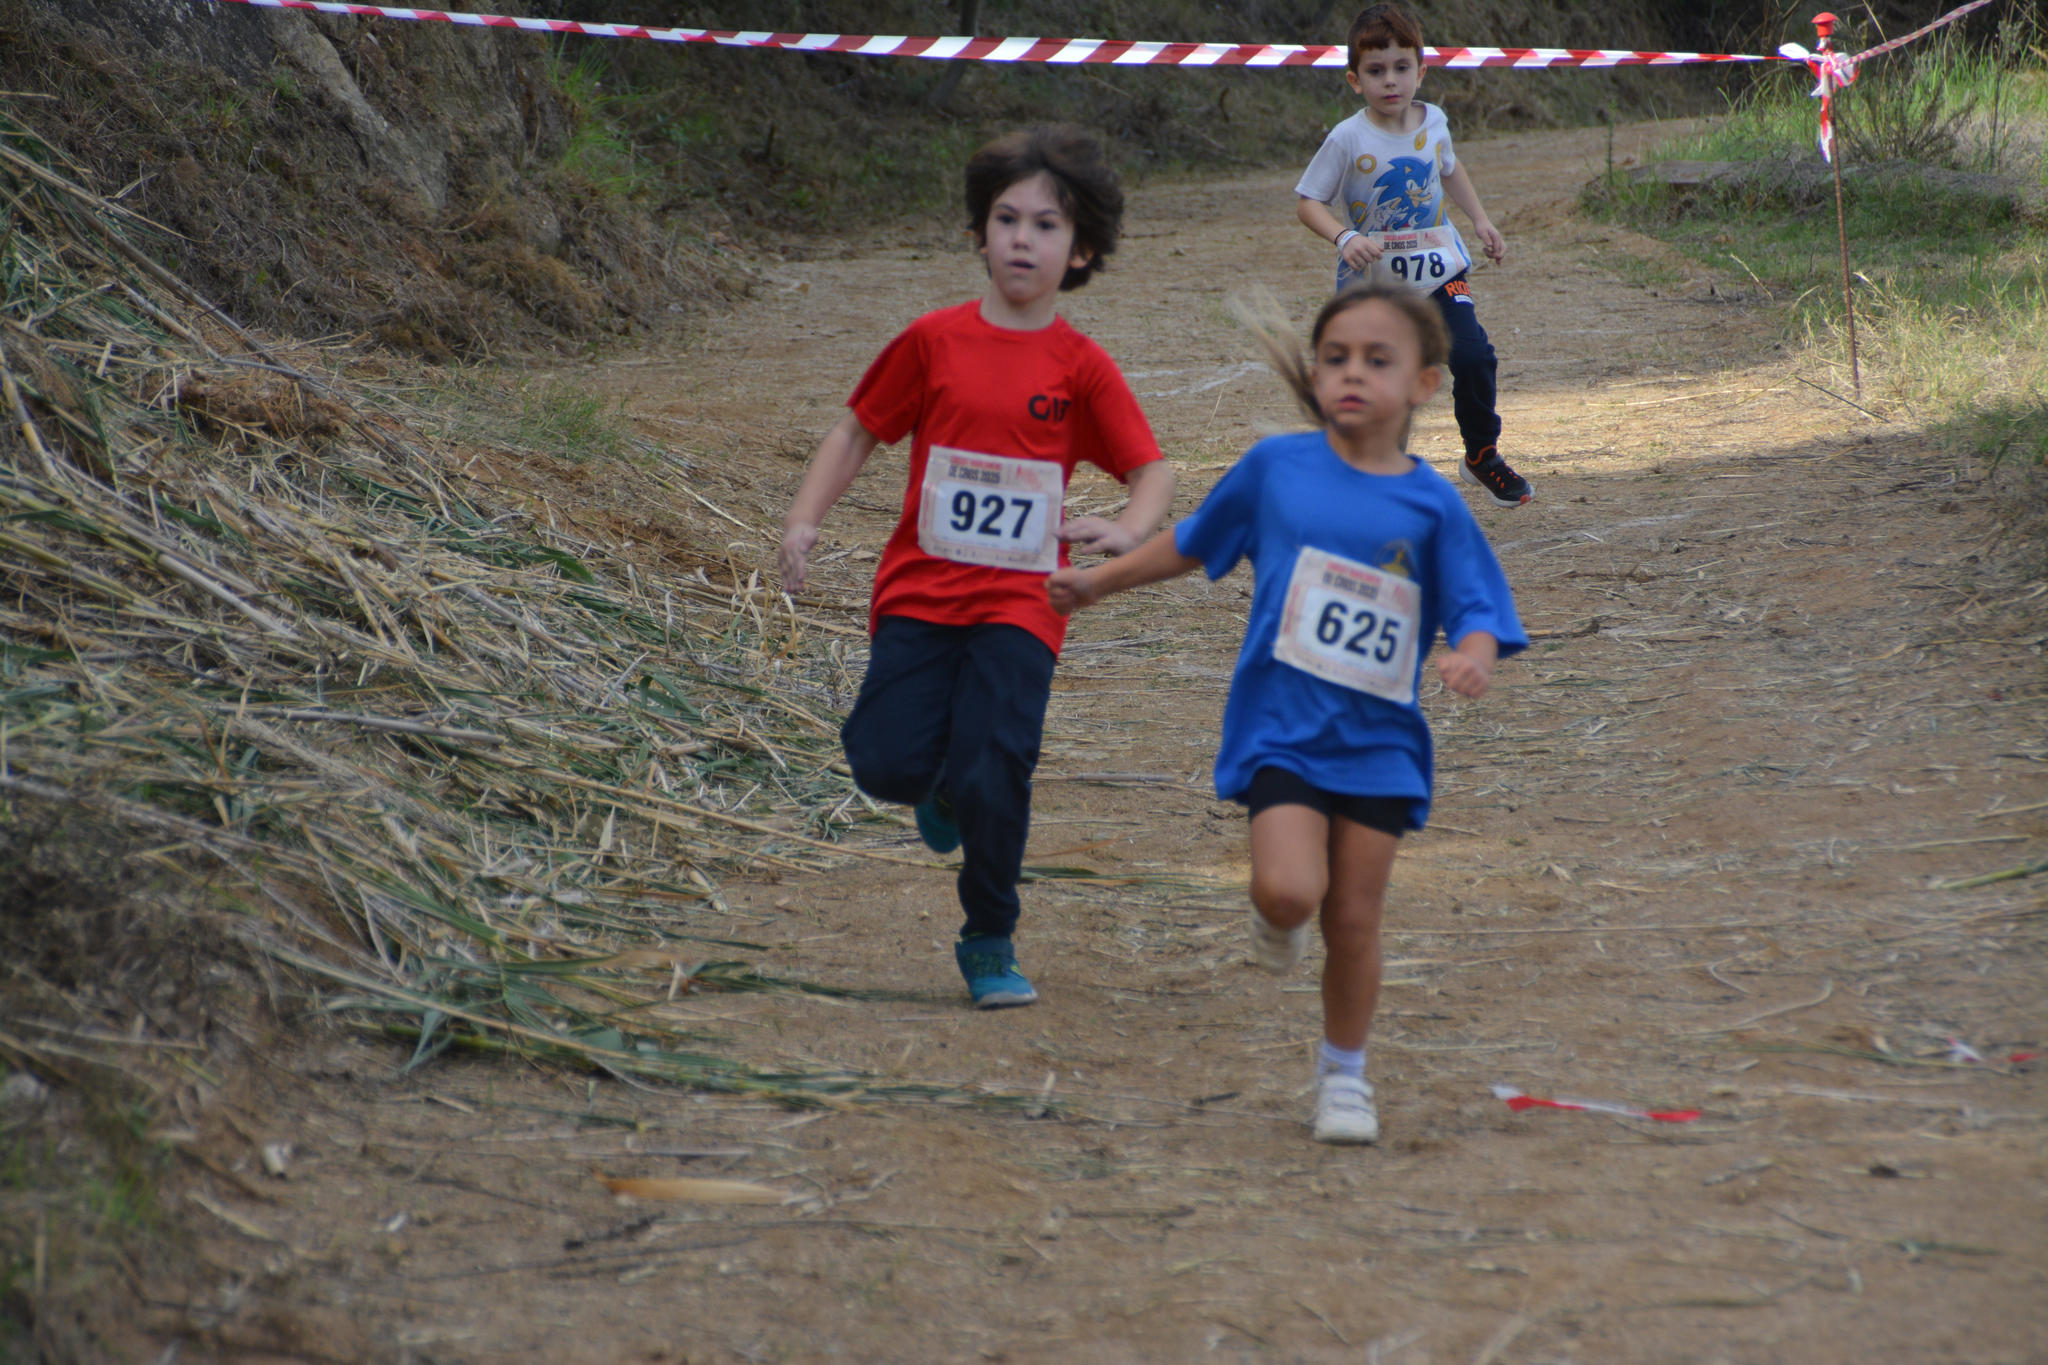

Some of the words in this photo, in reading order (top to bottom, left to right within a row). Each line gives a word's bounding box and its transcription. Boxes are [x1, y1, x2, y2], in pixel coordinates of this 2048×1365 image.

[1391, 252, 1445, 282] 978
[950, 490, 1033, 539] 927
[1316, 601, 1400, 663] 625
